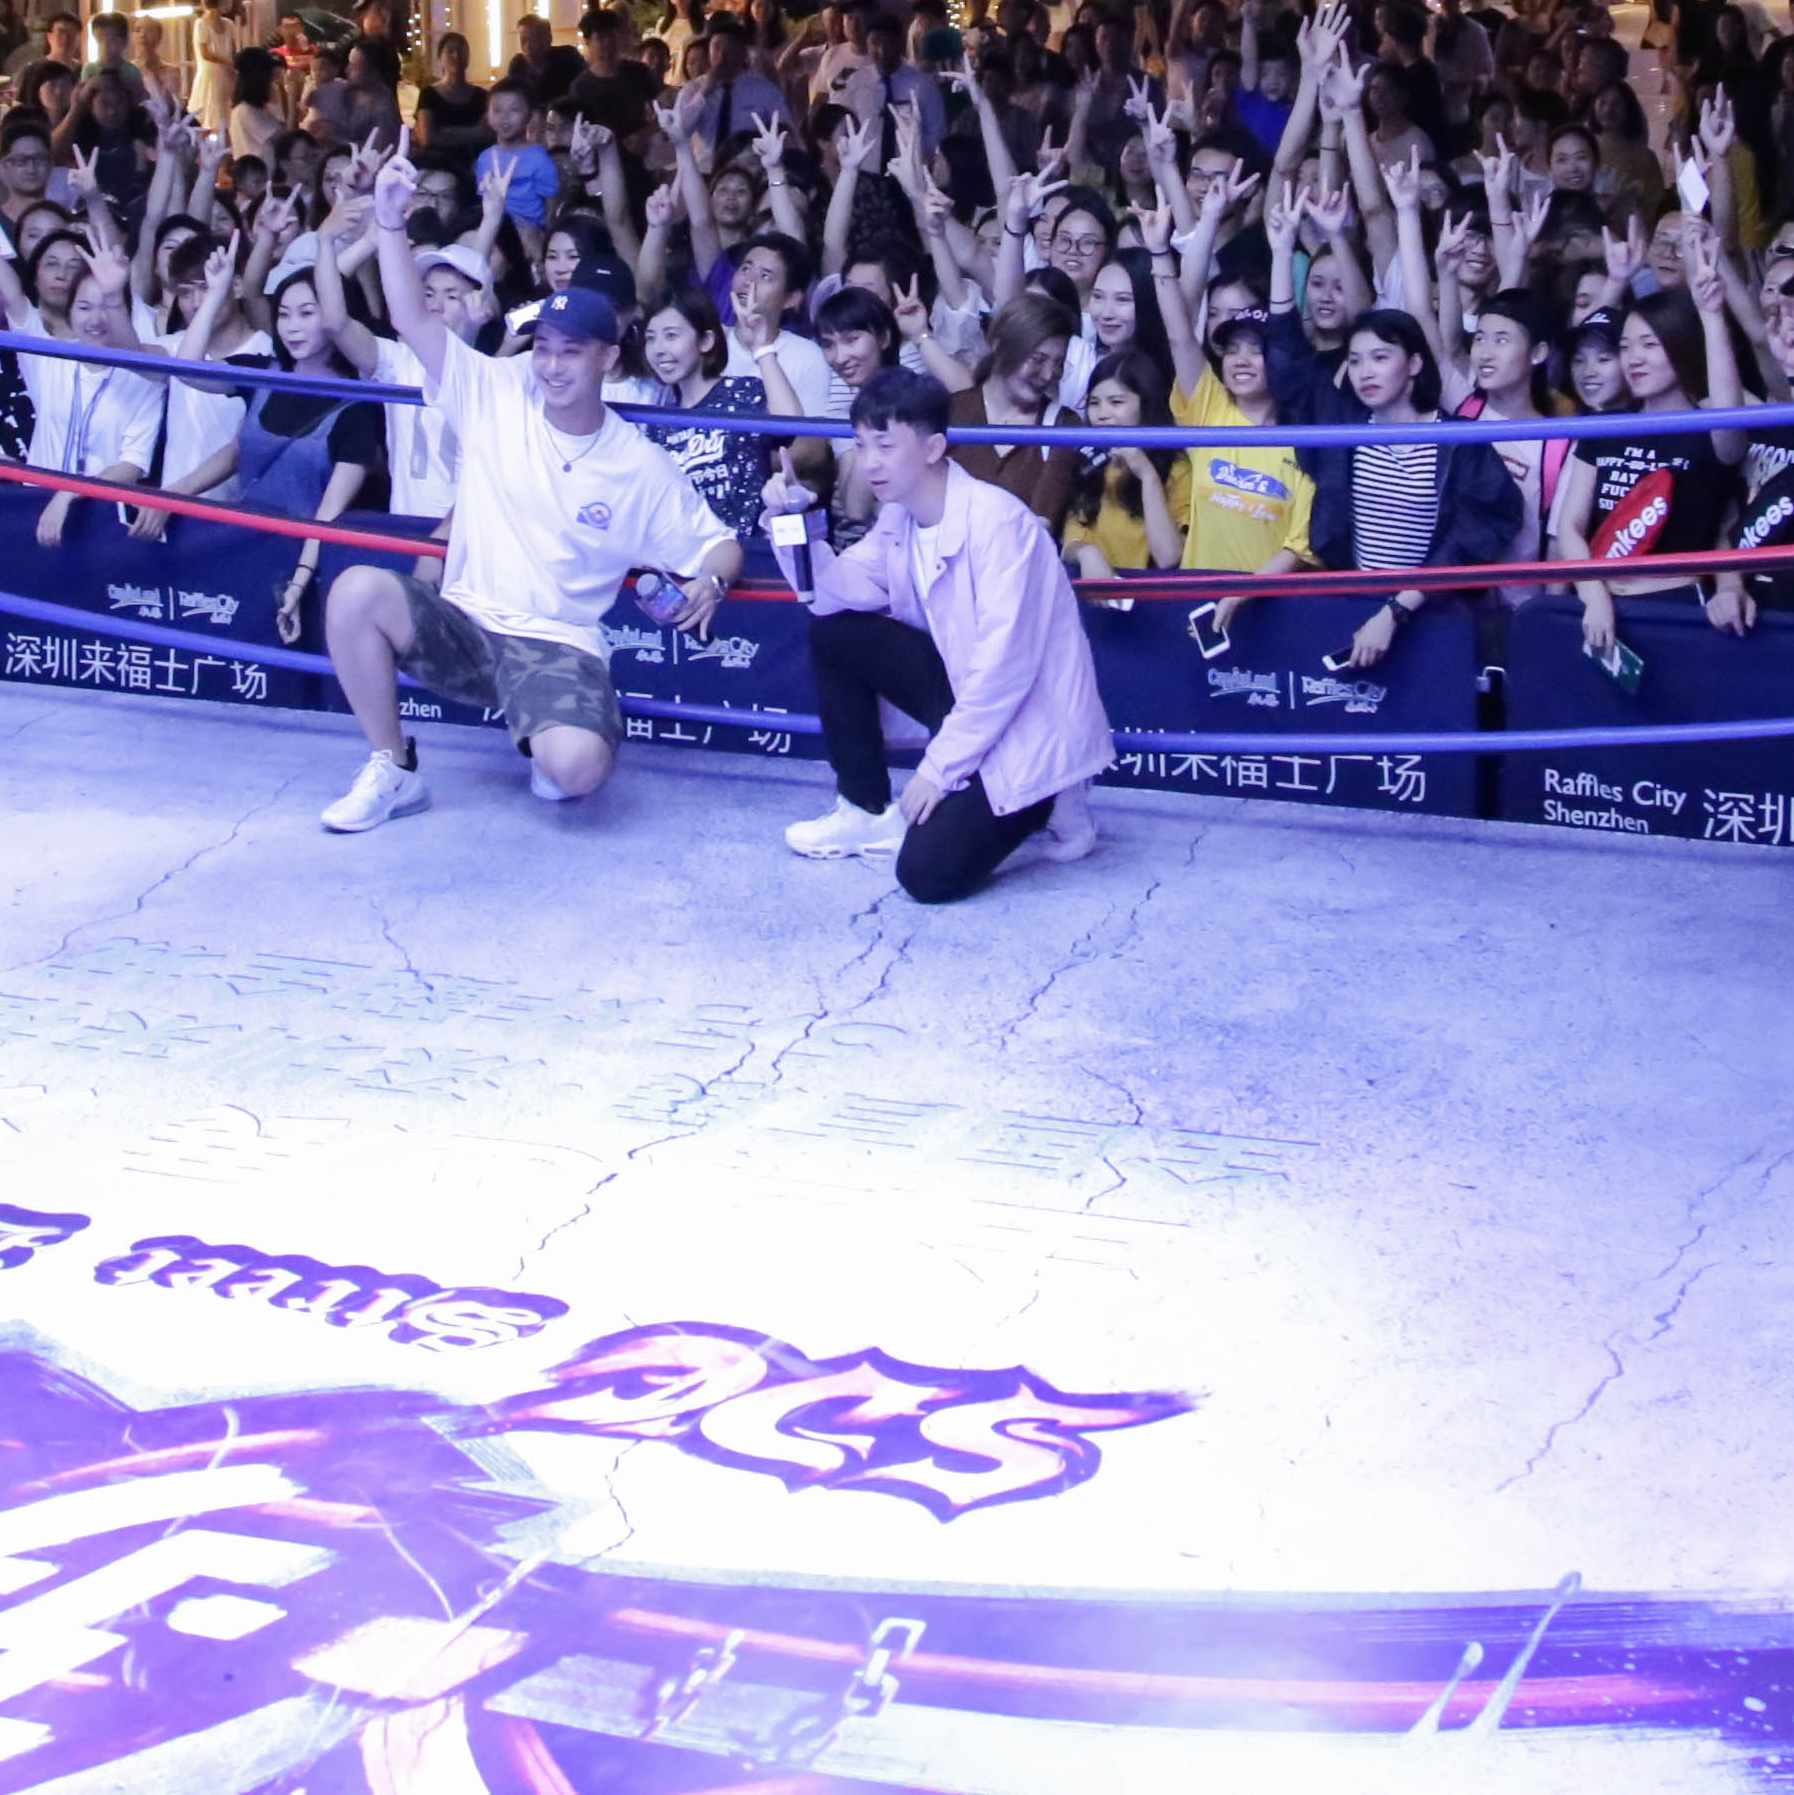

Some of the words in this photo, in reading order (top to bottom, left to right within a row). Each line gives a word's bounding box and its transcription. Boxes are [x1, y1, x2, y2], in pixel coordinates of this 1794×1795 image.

[1601, 483, 1633, 498] FUC
[4, 632, 268, 700] 深圳来福士广场
[398, 697, 442, 720] zhen
[1543, 768, 1623, 803] Raffles
[1632, 780, 1687, 814] City
[1542, 799, 1650, 834] Shenzhen
[93, 1233, 570, 1352] Street
